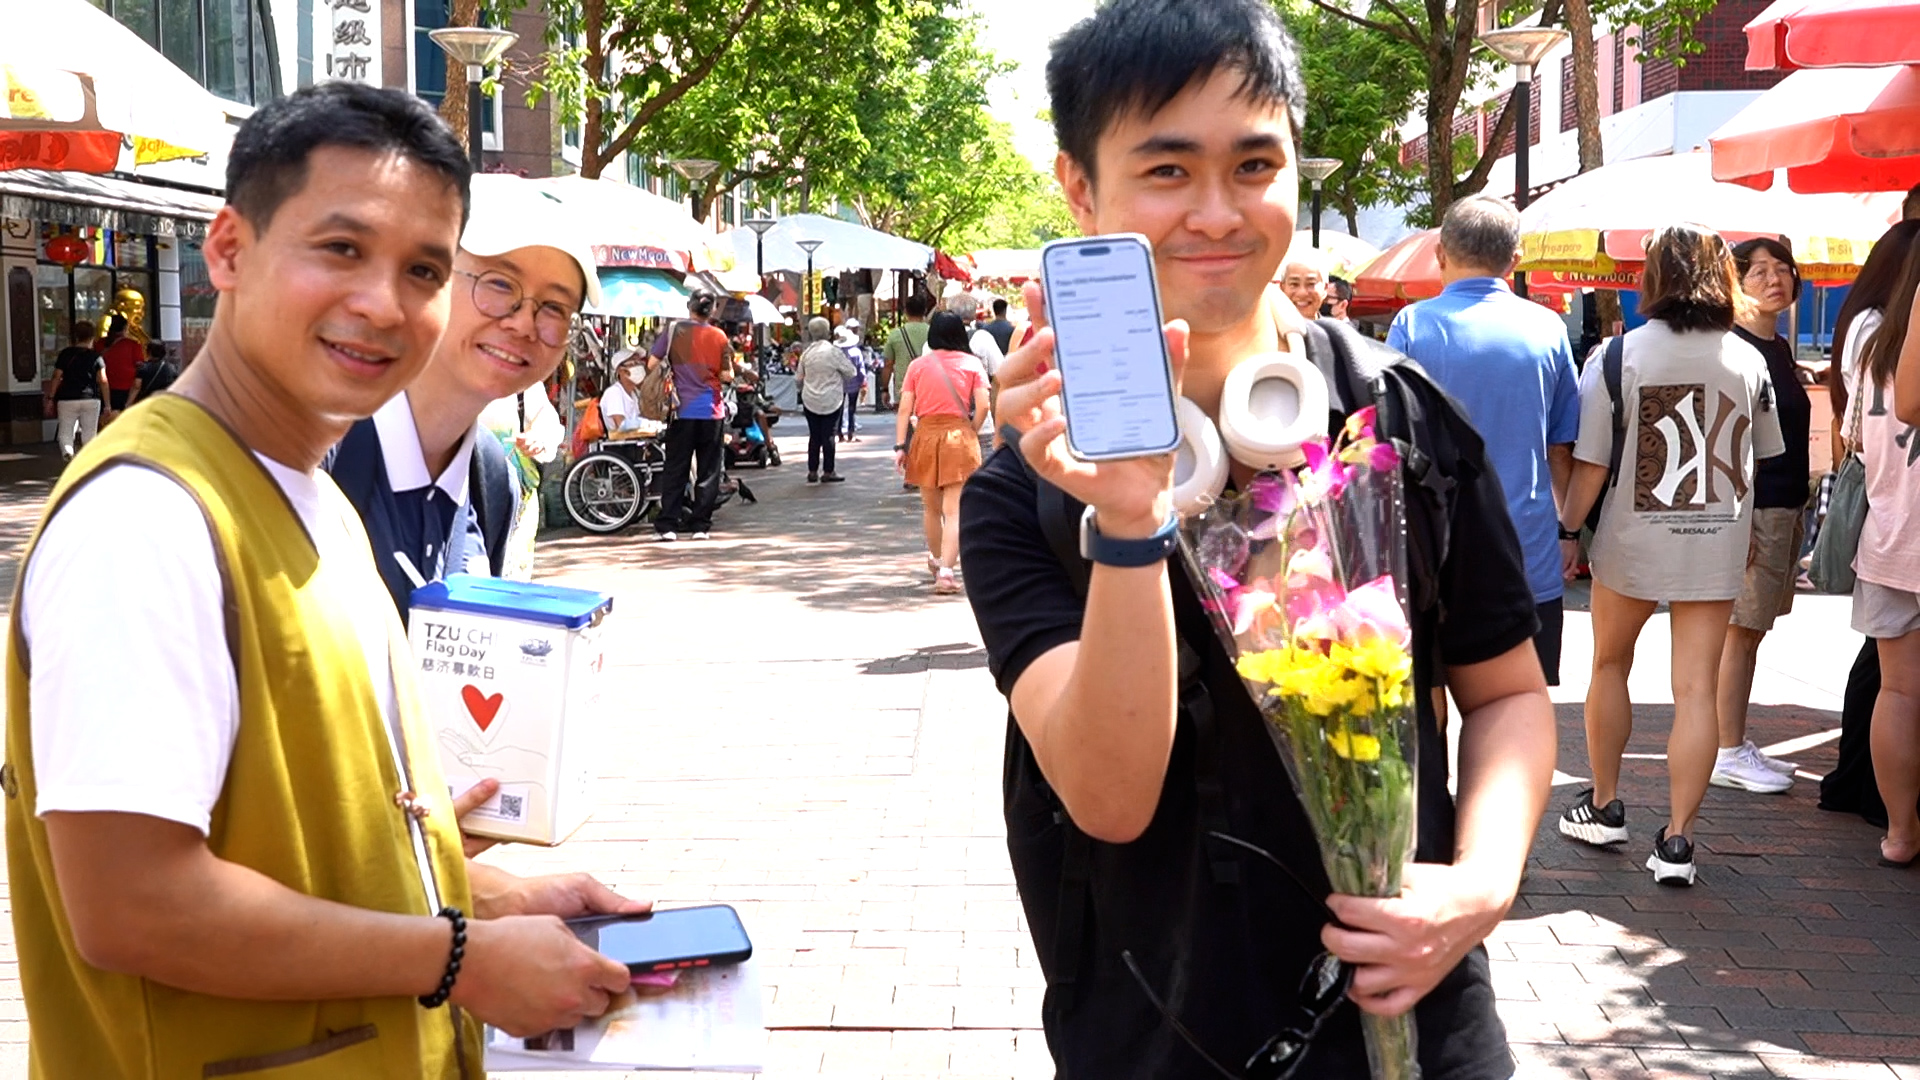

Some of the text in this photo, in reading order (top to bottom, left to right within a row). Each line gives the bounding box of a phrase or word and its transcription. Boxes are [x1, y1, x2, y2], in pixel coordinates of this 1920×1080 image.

[423, 622, 460, 641] TZU
[426, 639, 486, 661] Flag Day
